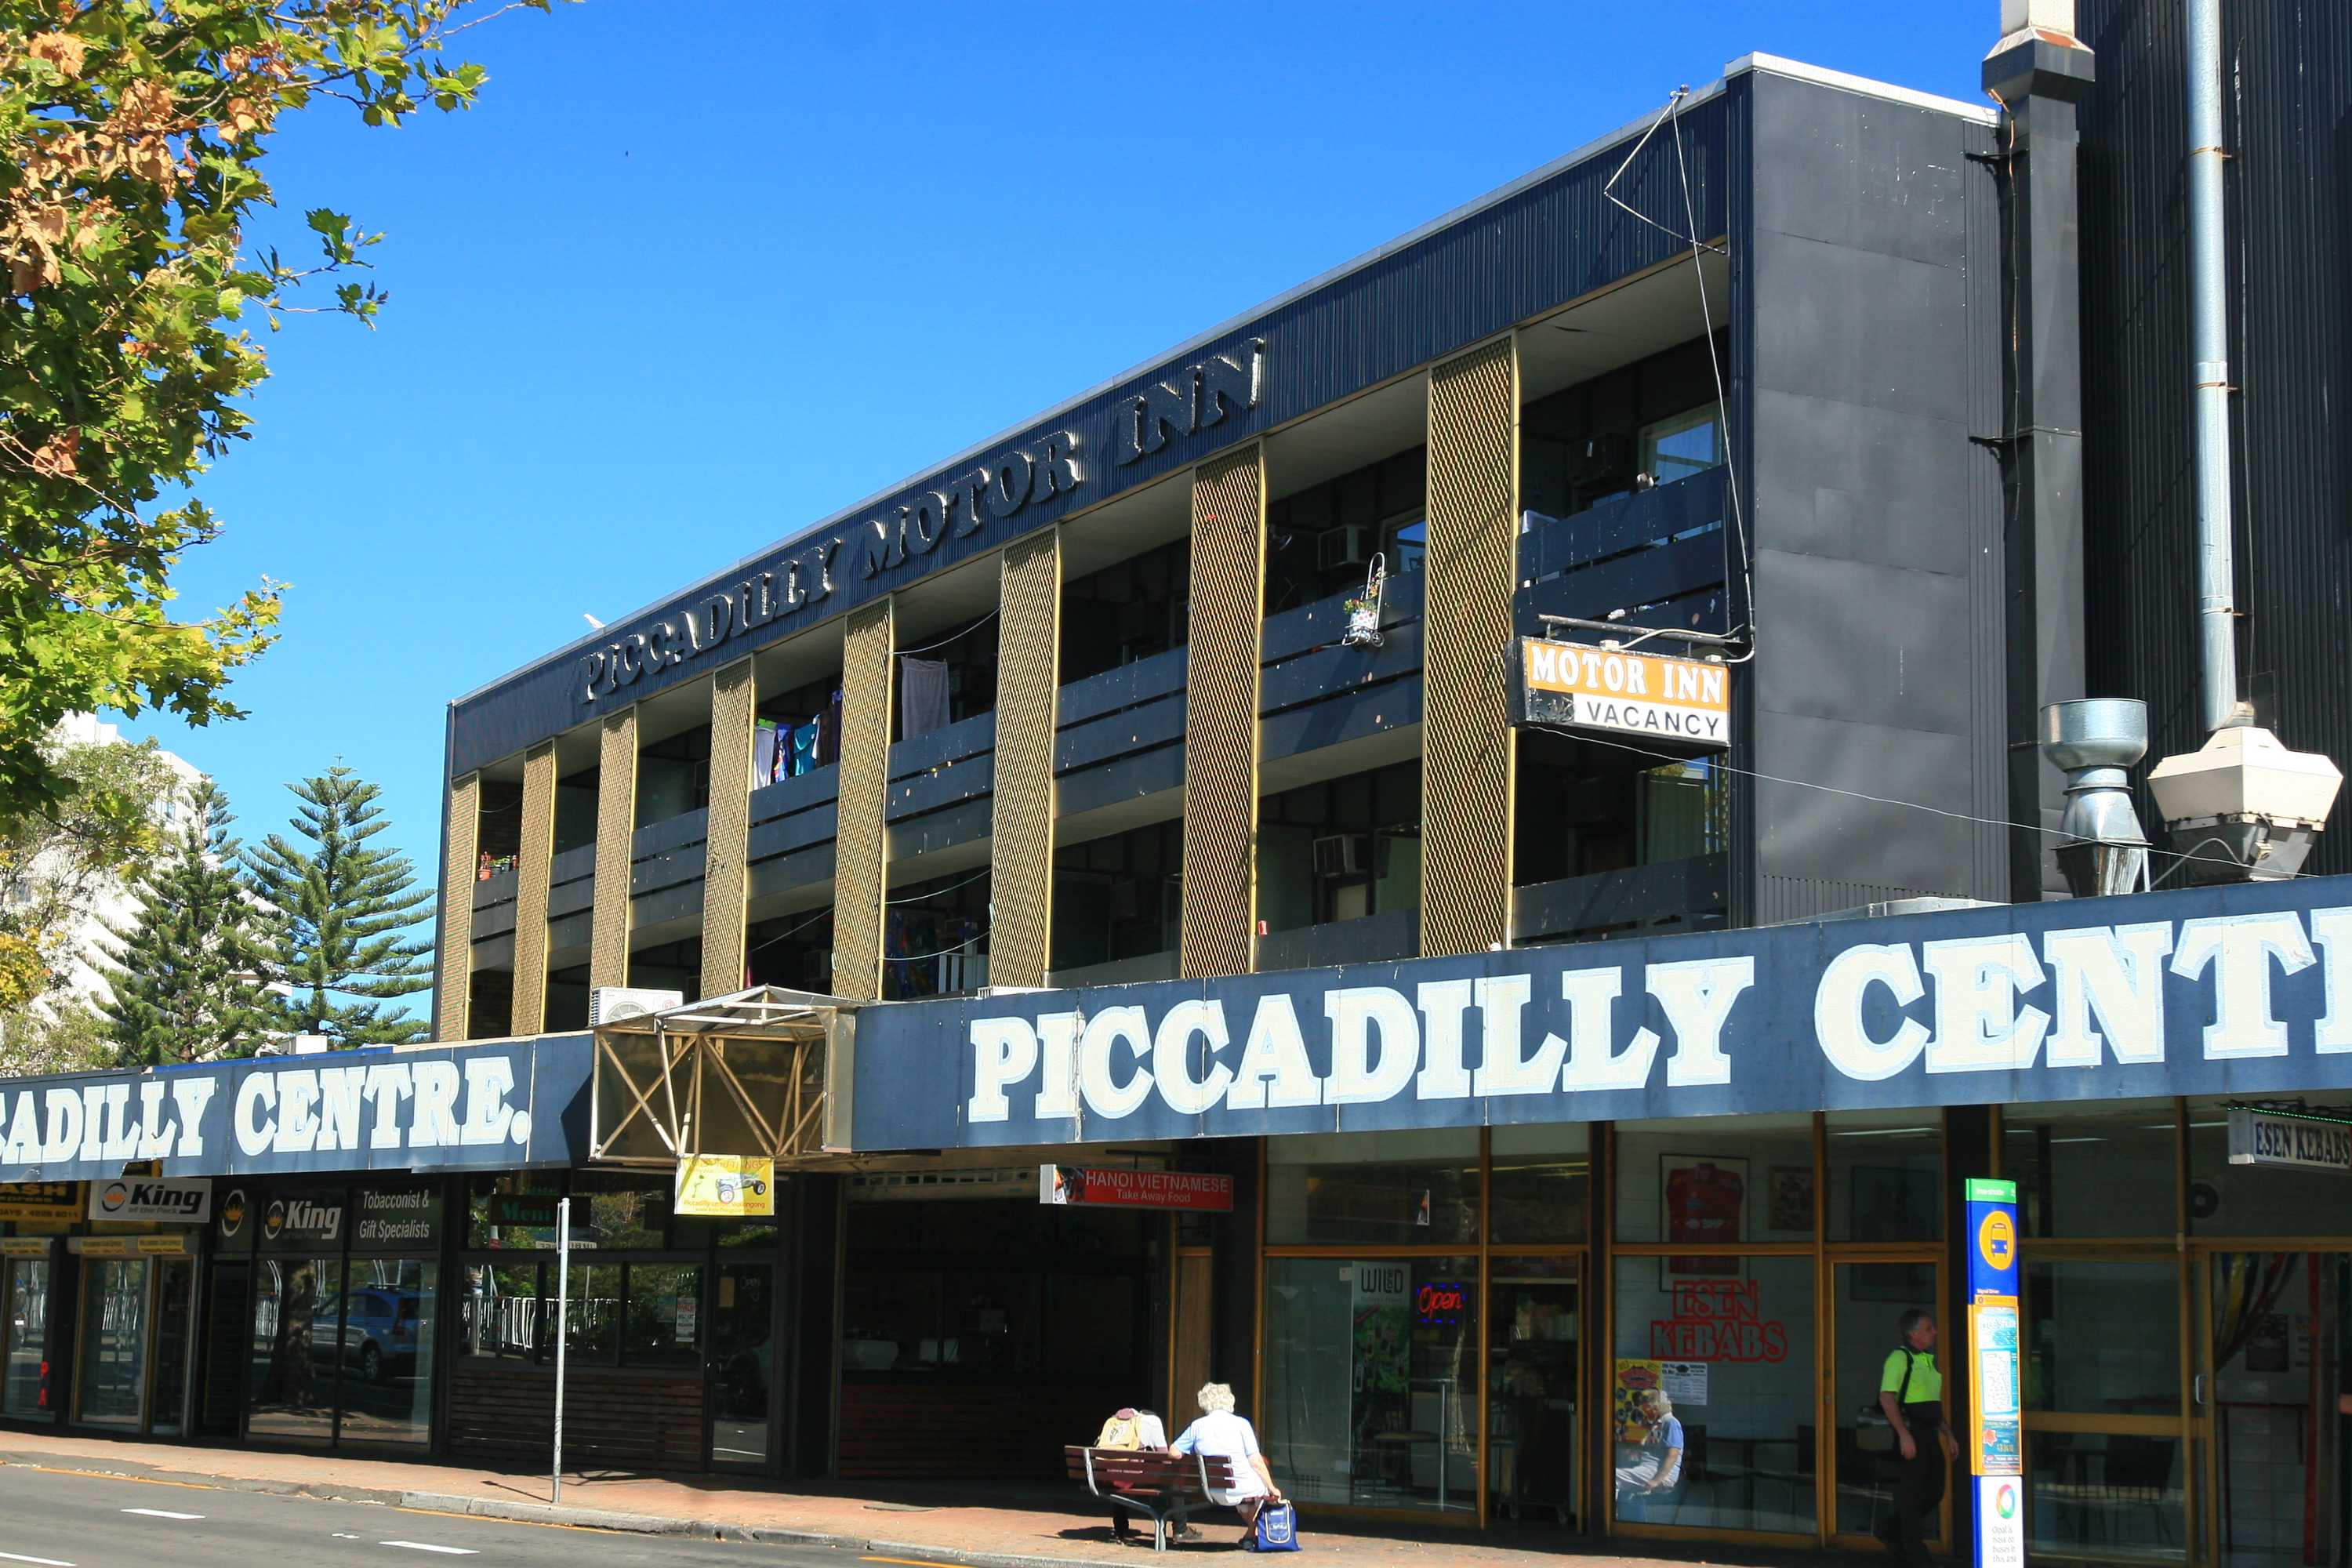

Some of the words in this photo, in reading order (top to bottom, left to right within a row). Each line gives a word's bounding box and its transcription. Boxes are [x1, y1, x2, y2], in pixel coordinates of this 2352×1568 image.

[578, 538, 842, 705] PICCADILLY
[862, 431, 1083, 579] MOTOR
[1116, 337, 1265, 466] INN
[1532, 646, 1646, 695] MOTOR
[1662, 662, 1723, 704] INN
[1587, 701, 1719, 737] VACANCY
[967, 956, 1755, 1123] PICCADILLY
[0, 1076, 216, 1165] ADILLY
[234, 1056, 532, 1157] CENTRE.
[2255, 1121, 2292, 1158] ESEN
[2296, 1127, 2350, 1165] KEBABS
[130, 1184, 204, 1214] King
[363, 1190, 420, 1210] Tobacconist
[422, 1189, 430, 1207] &
[1086, 1171, 1133, 1187] HANOI
[1138, 1174, 1229, 1192] VIETNAMESE
[1117, 1189, 1138, 1200] Take
[1141, 1190, 1166, 1203] Away
[1168, 1192, 1190, 1203] Food
[285, 1201, 343, 1240] King
[359, 1220, 376, 1239] Gift
[378, 1220, 430, 1242] Specialists
[1361, 1268, 1403, 1294] WILD
[1673, 1279, 1757, 1320] ESEN
[1419, 1287, 1464, 1318] Open
[1650, 1318, 1788, 1362] KEBABS
